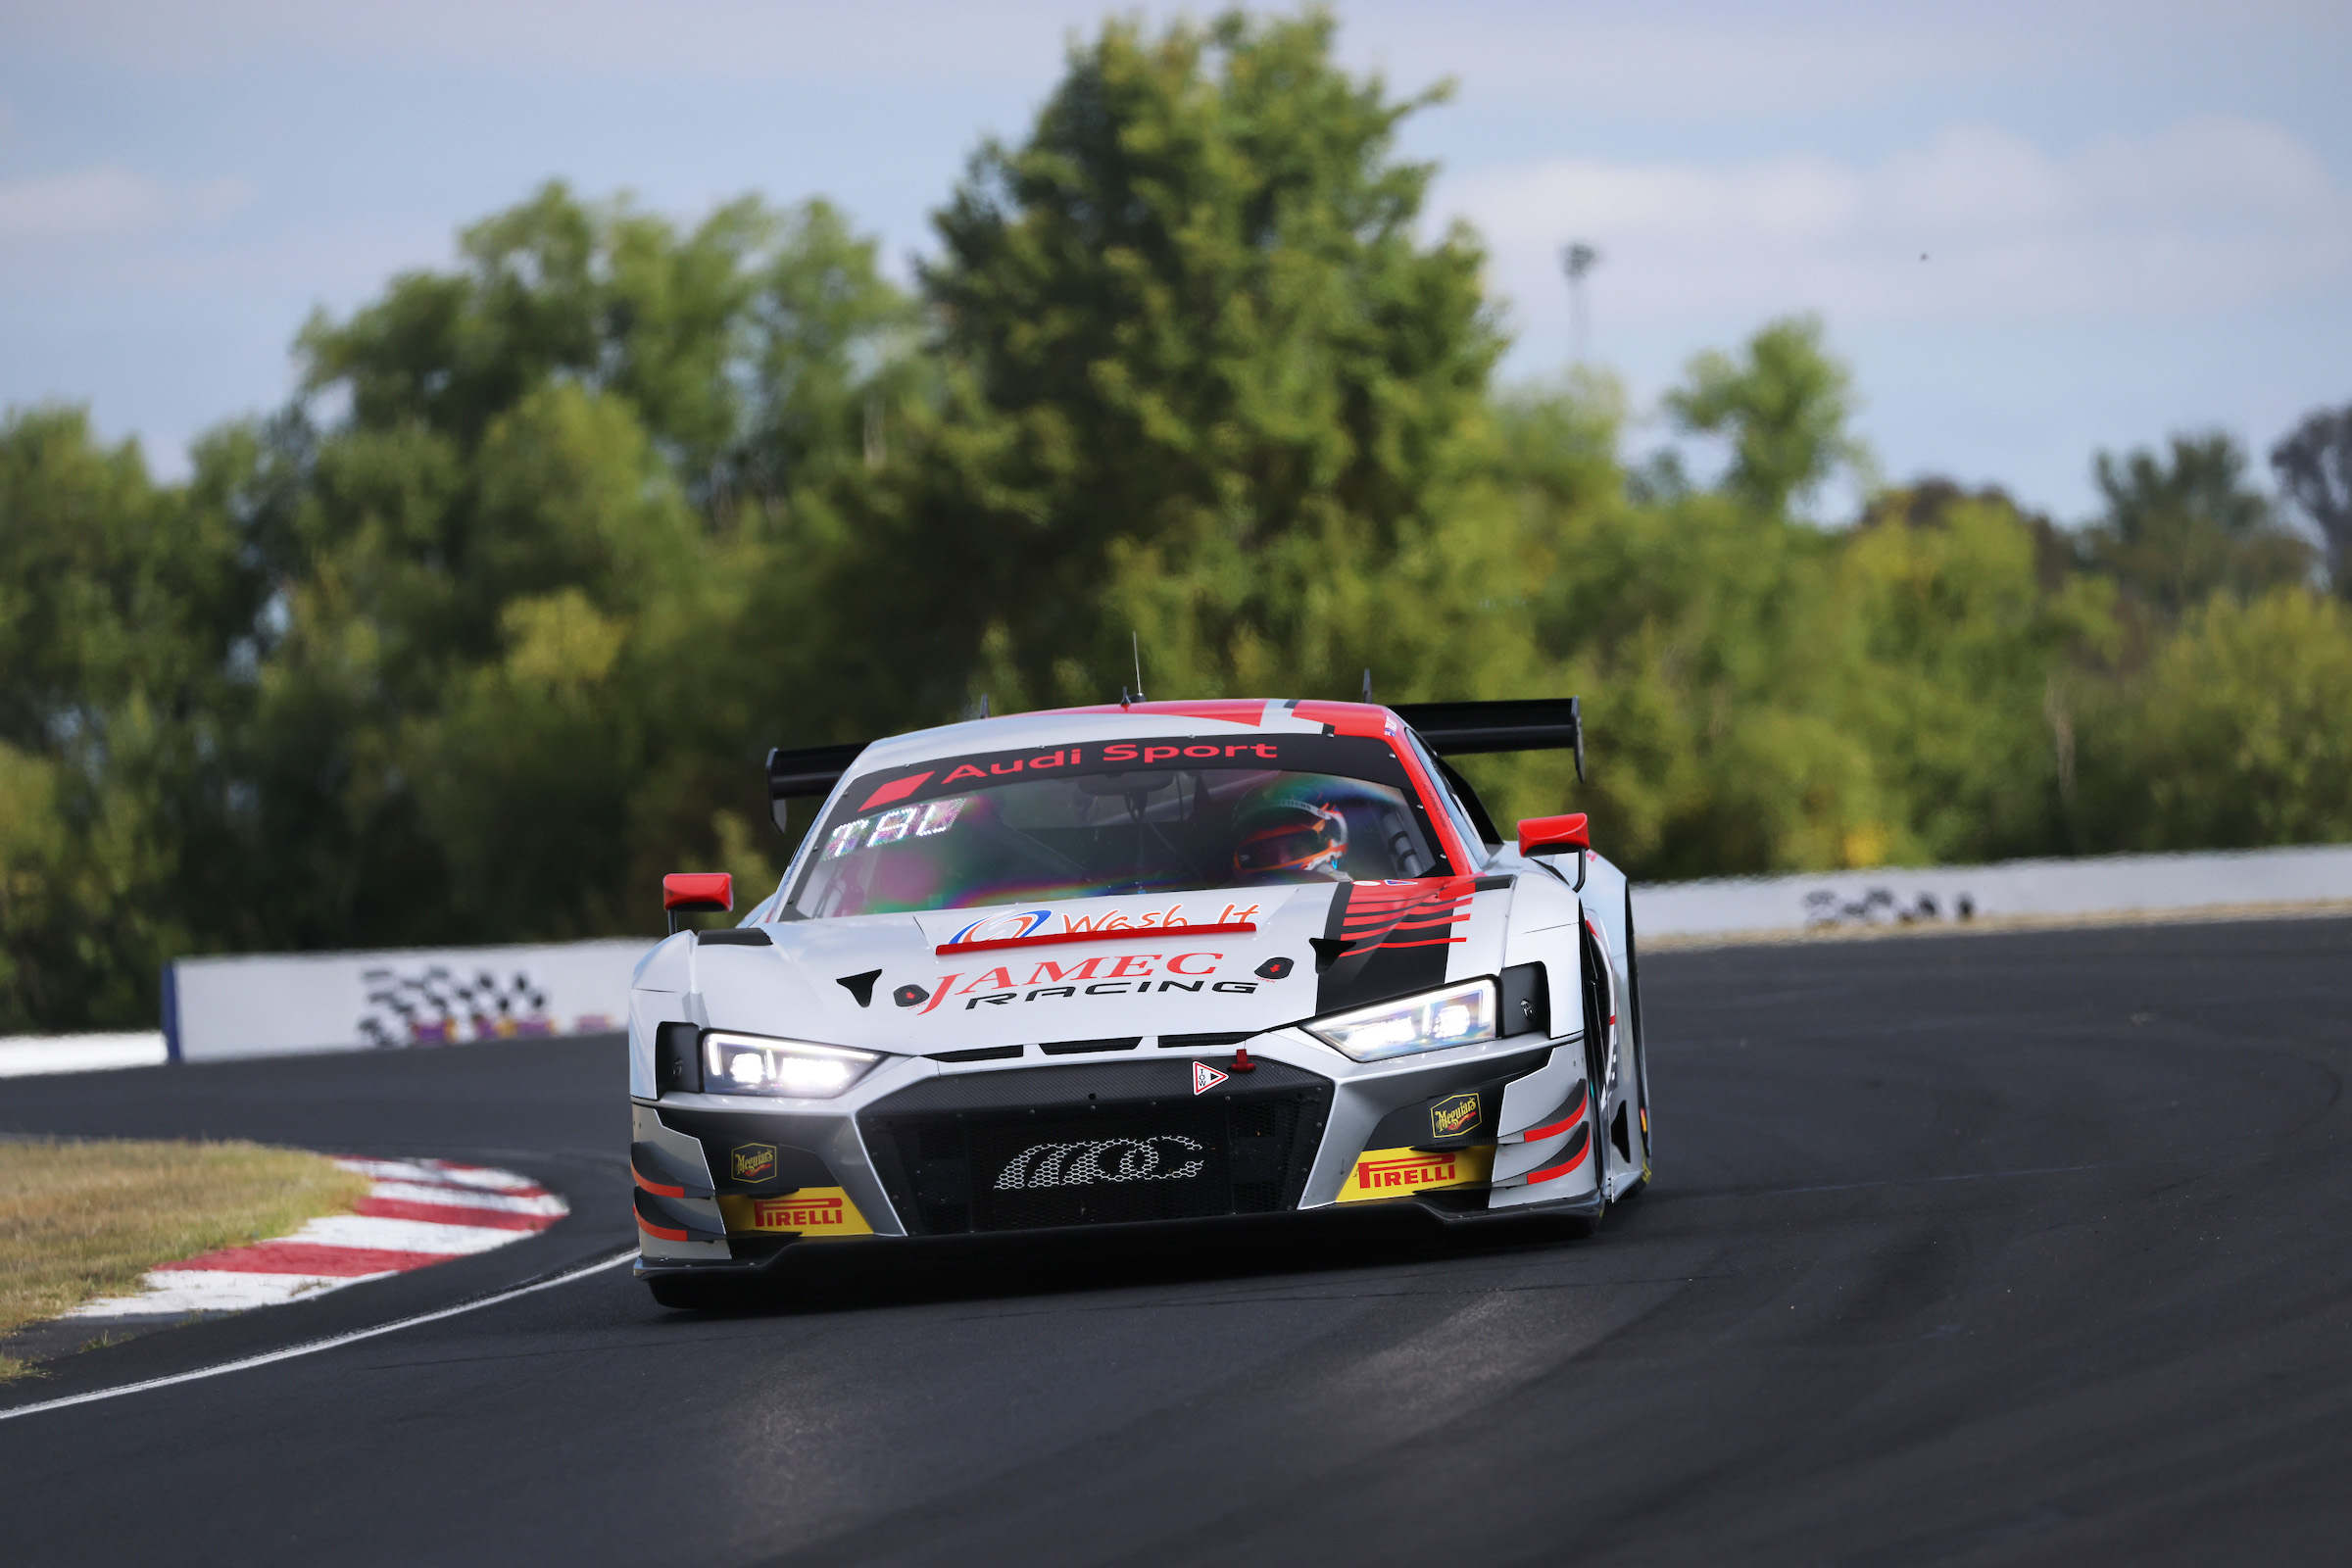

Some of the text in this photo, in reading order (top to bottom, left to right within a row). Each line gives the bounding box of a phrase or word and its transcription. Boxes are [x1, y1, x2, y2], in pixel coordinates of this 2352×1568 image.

[941, 743, 1278, 784] Audi Sport
[832, 805, 948, 858] TAL
[1062, 904, 1260, 934] Wash It
[916, 952, 1224, 1016] JAMEC
[965, 980, 1259, 1010] RACING
[1198, 1068, 1206, 1087] TOW
[1434, 1097, 1477, 1132] Meguiar's
[1357, 1152, 1456, 1189] PIRELLI
[754, 1198, 843, 1227] PIRELLI
